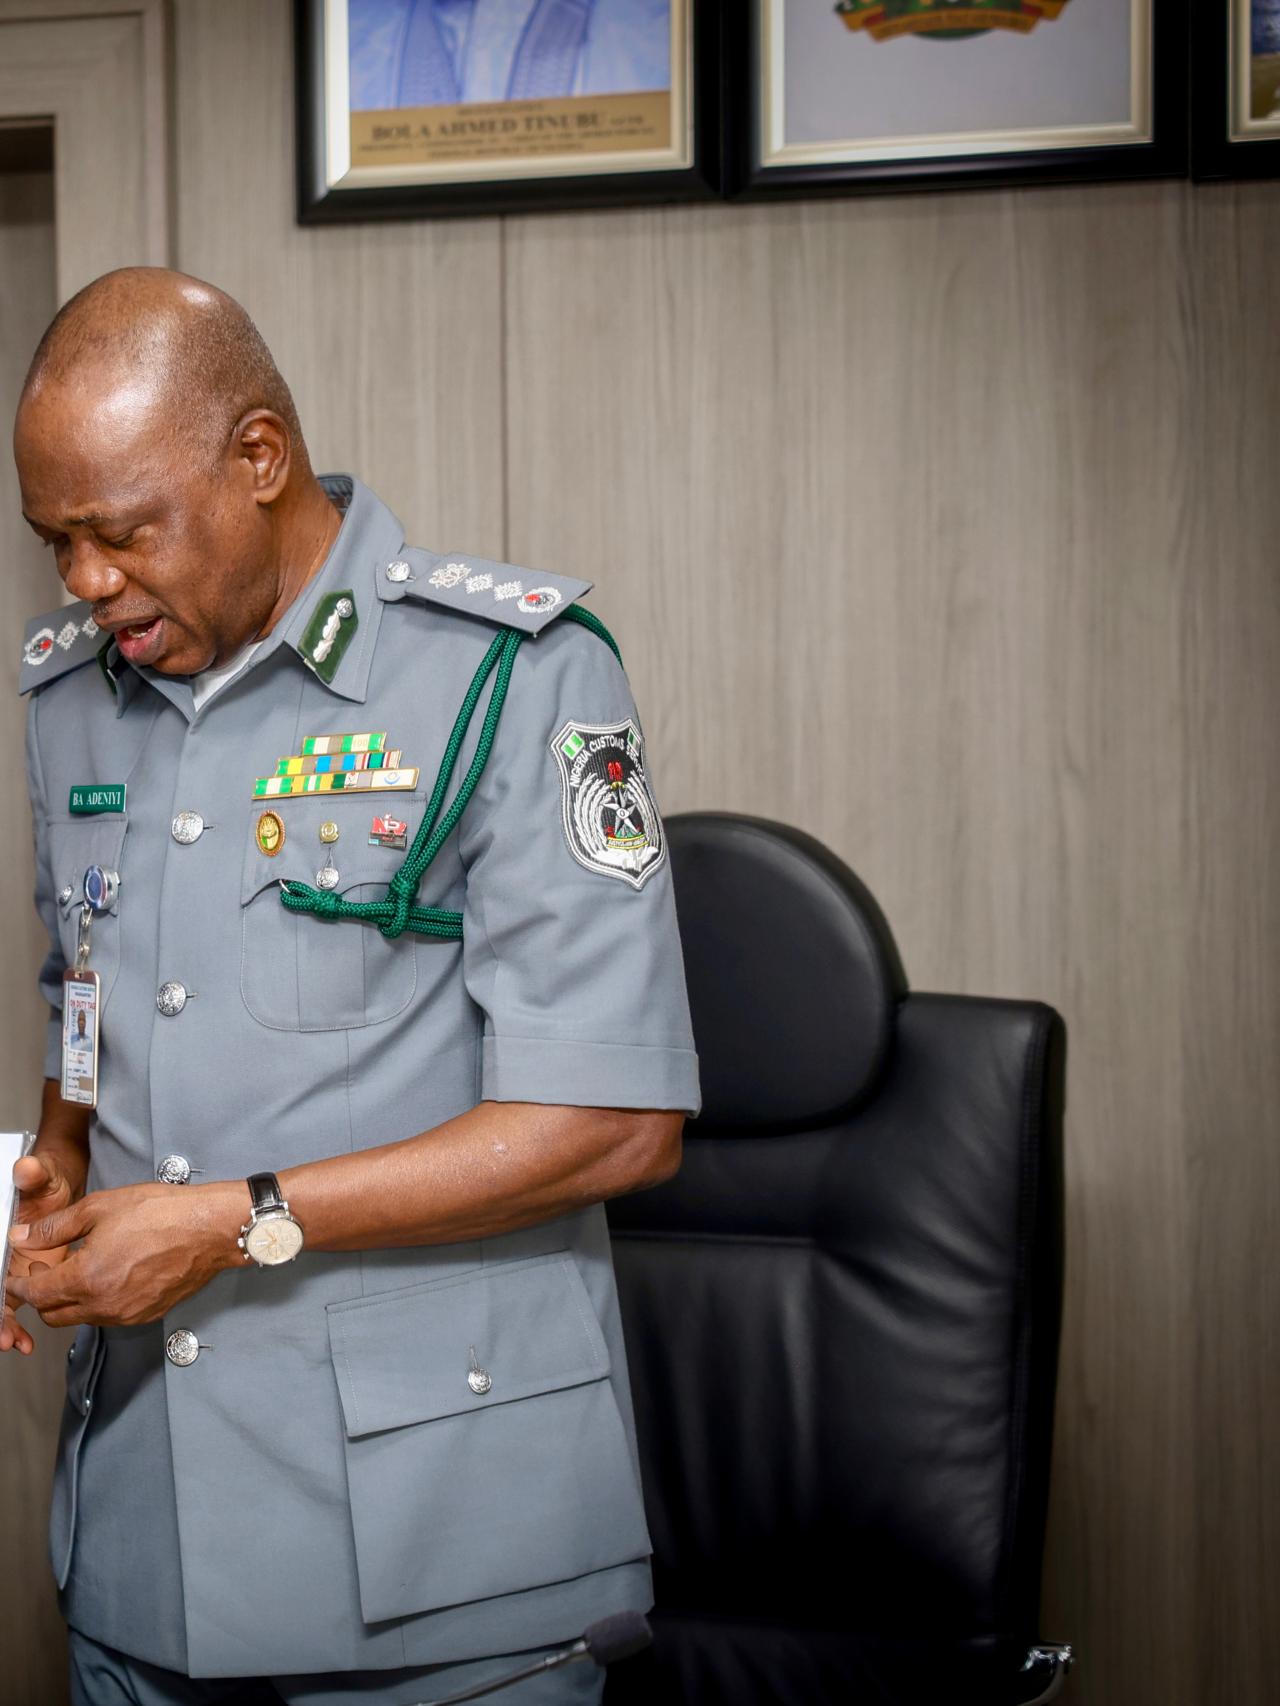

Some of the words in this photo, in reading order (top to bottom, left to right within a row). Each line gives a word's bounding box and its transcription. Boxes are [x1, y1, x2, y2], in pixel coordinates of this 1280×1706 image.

[437, 118, 518, 137] AHMED
[569, 749, 593, 788] NIGERIA
[589, 734, 625, 753] CUSTOMS
[72, 792, 83, 806] BA
[86, 791, 121, 805] ADENIYI
